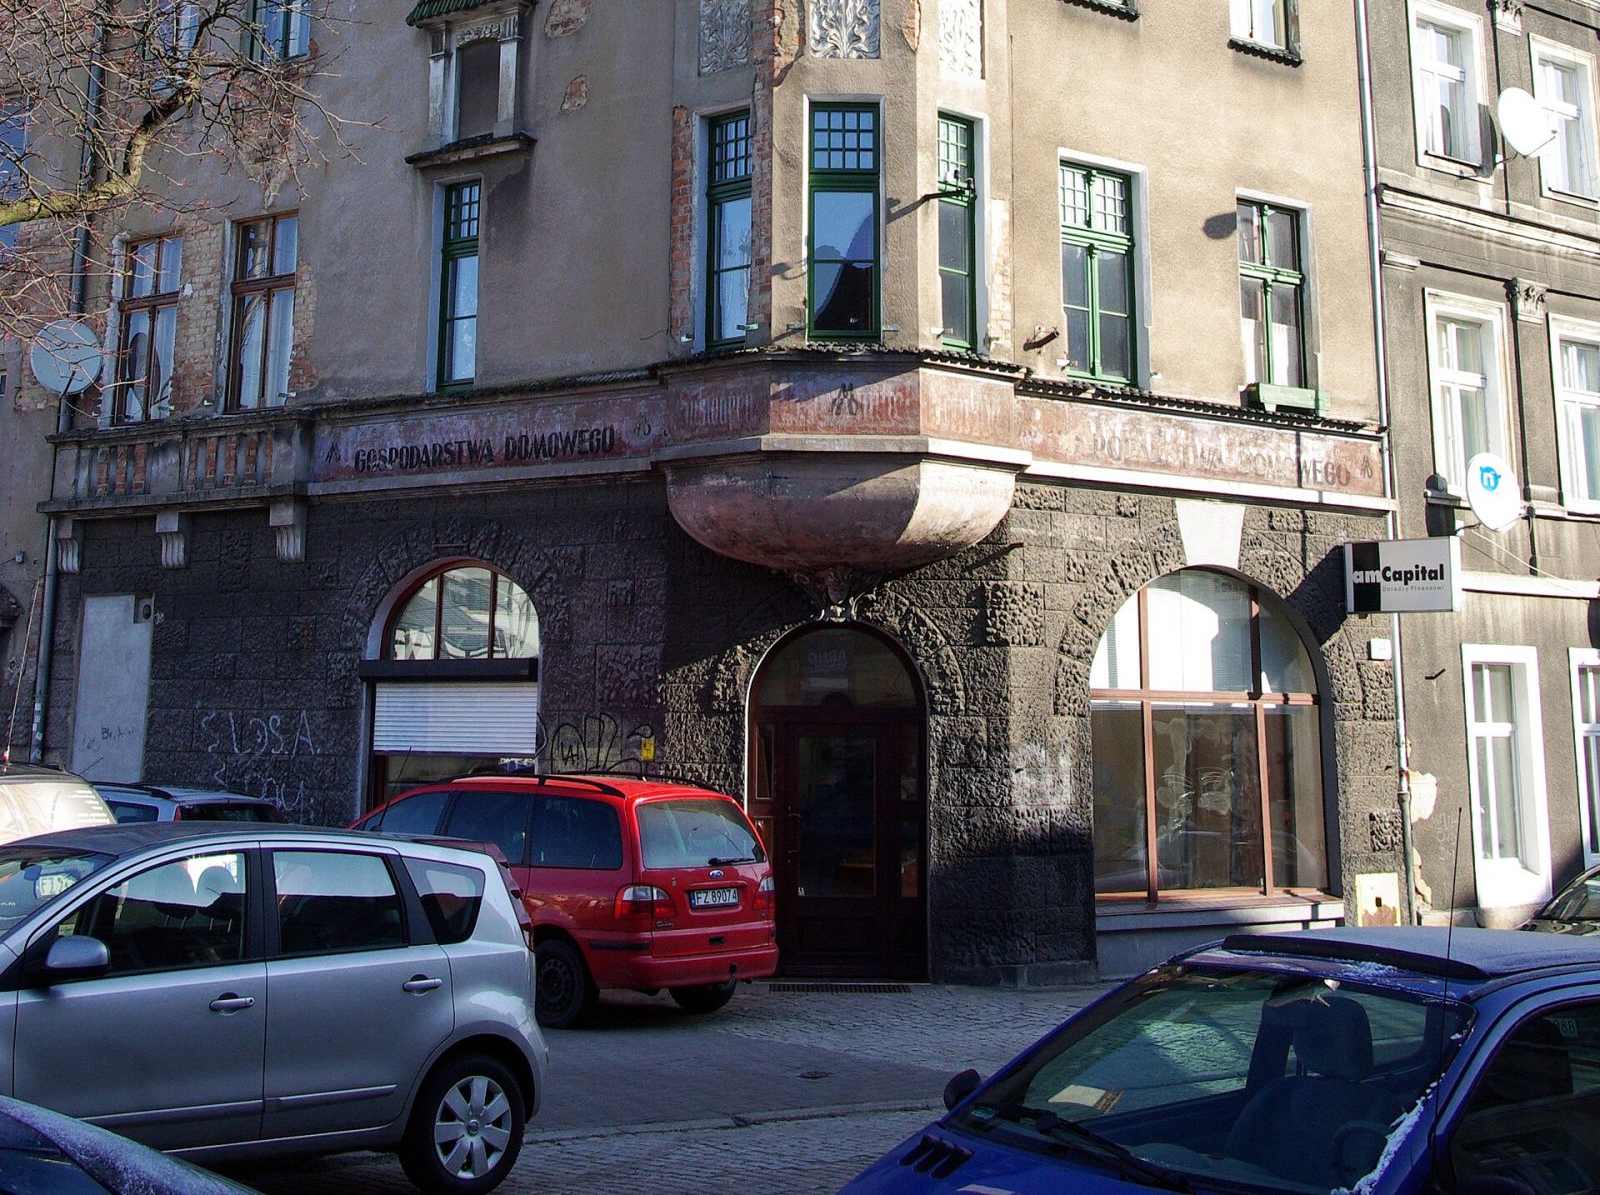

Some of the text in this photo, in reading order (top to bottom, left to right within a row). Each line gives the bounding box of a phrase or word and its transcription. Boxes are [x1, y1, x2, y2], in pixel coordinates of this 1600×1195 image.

[354, 427, 615, 472] GOSPODARSTWA DOMOWEGO
[1353, 564, 1445, 585] amCapital
[696, 889, 737, 904] FZ 89074
